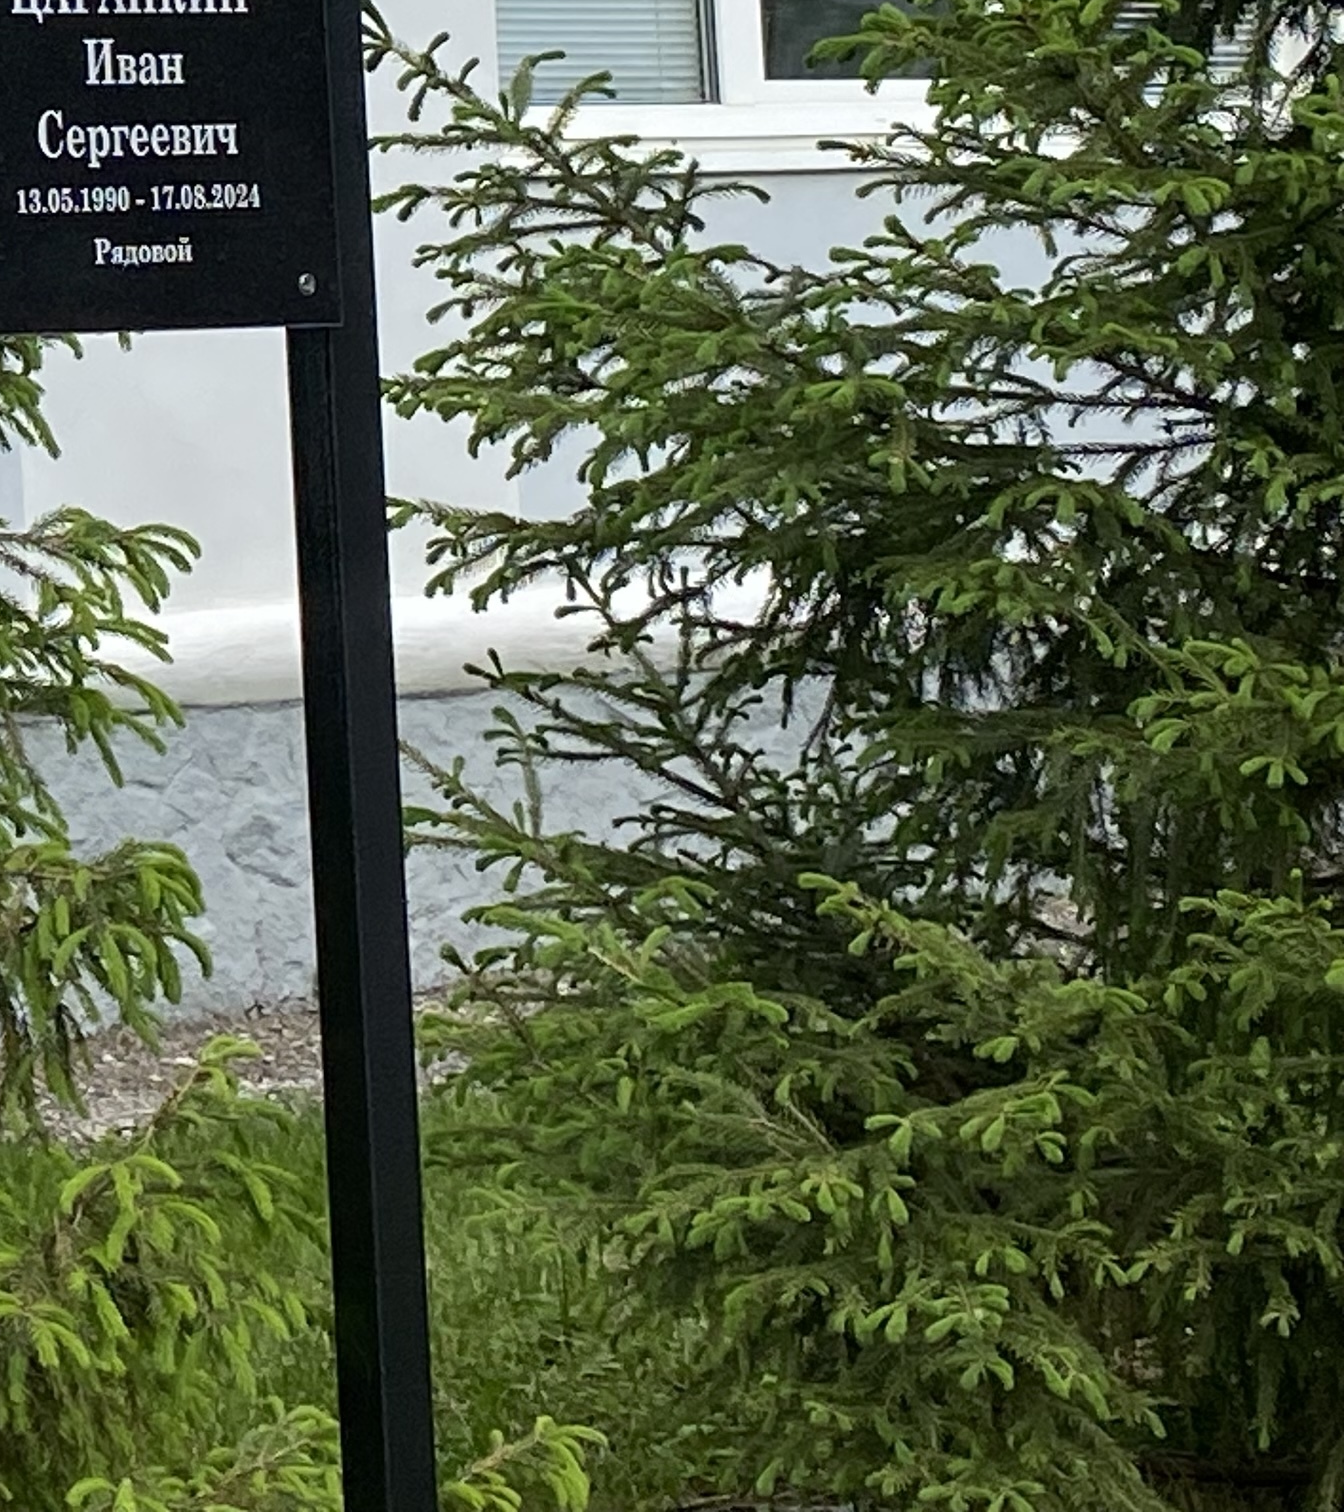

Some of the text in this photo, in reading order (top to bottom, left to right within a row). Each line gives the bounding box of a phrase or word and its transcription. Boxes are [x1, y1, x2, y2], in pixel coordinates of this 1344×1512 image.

[82, 37, 186, 86] Иван
[37, 109, 239, 169] Сергеевич
[16, 185, 130, 214] 13.05.1990
[150, 183, 261, 211] 17.08.2024
[93, 236, 193, 267] Рядовой
